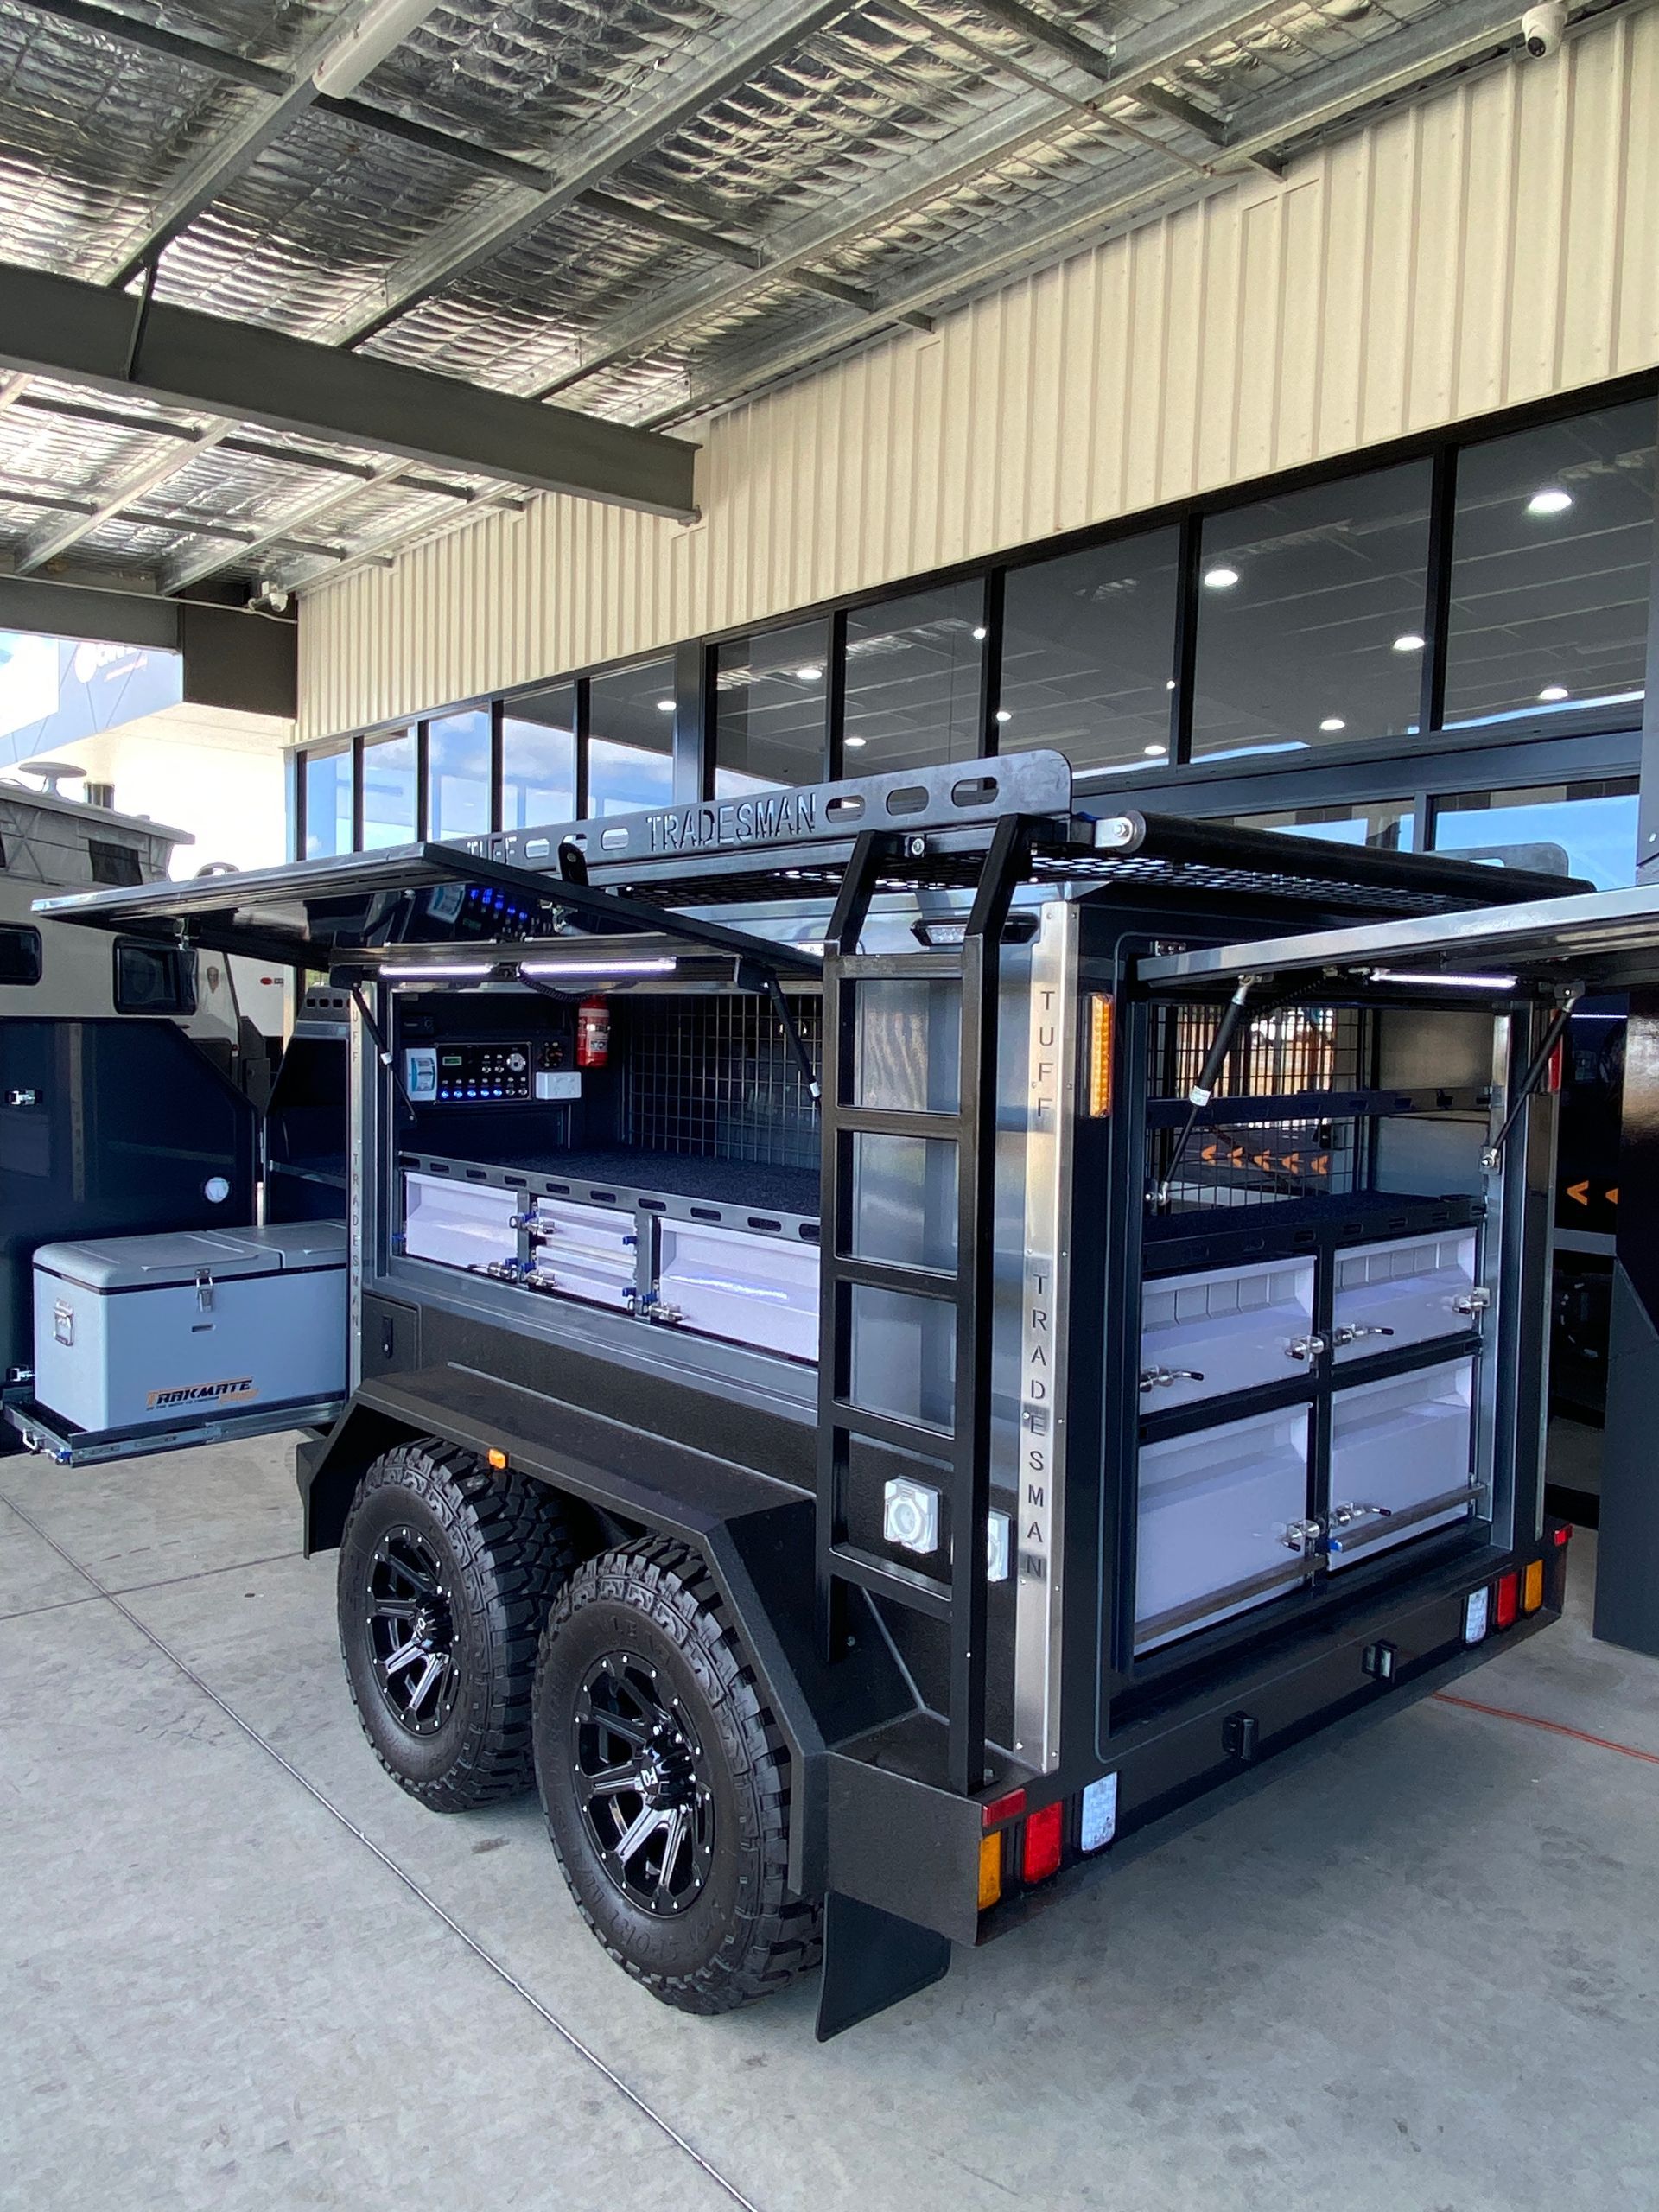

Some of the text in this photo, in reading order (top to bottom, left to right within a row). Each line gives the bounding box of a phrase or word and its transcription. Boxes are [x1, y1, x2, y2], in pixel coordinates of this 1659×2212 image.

[646, 792, 816, 852] TRADESMAN
[351, 1152, 359, 1327] TRADESMAN
[1026, 990, 1055, 1579] TUFF TRADESMAN
